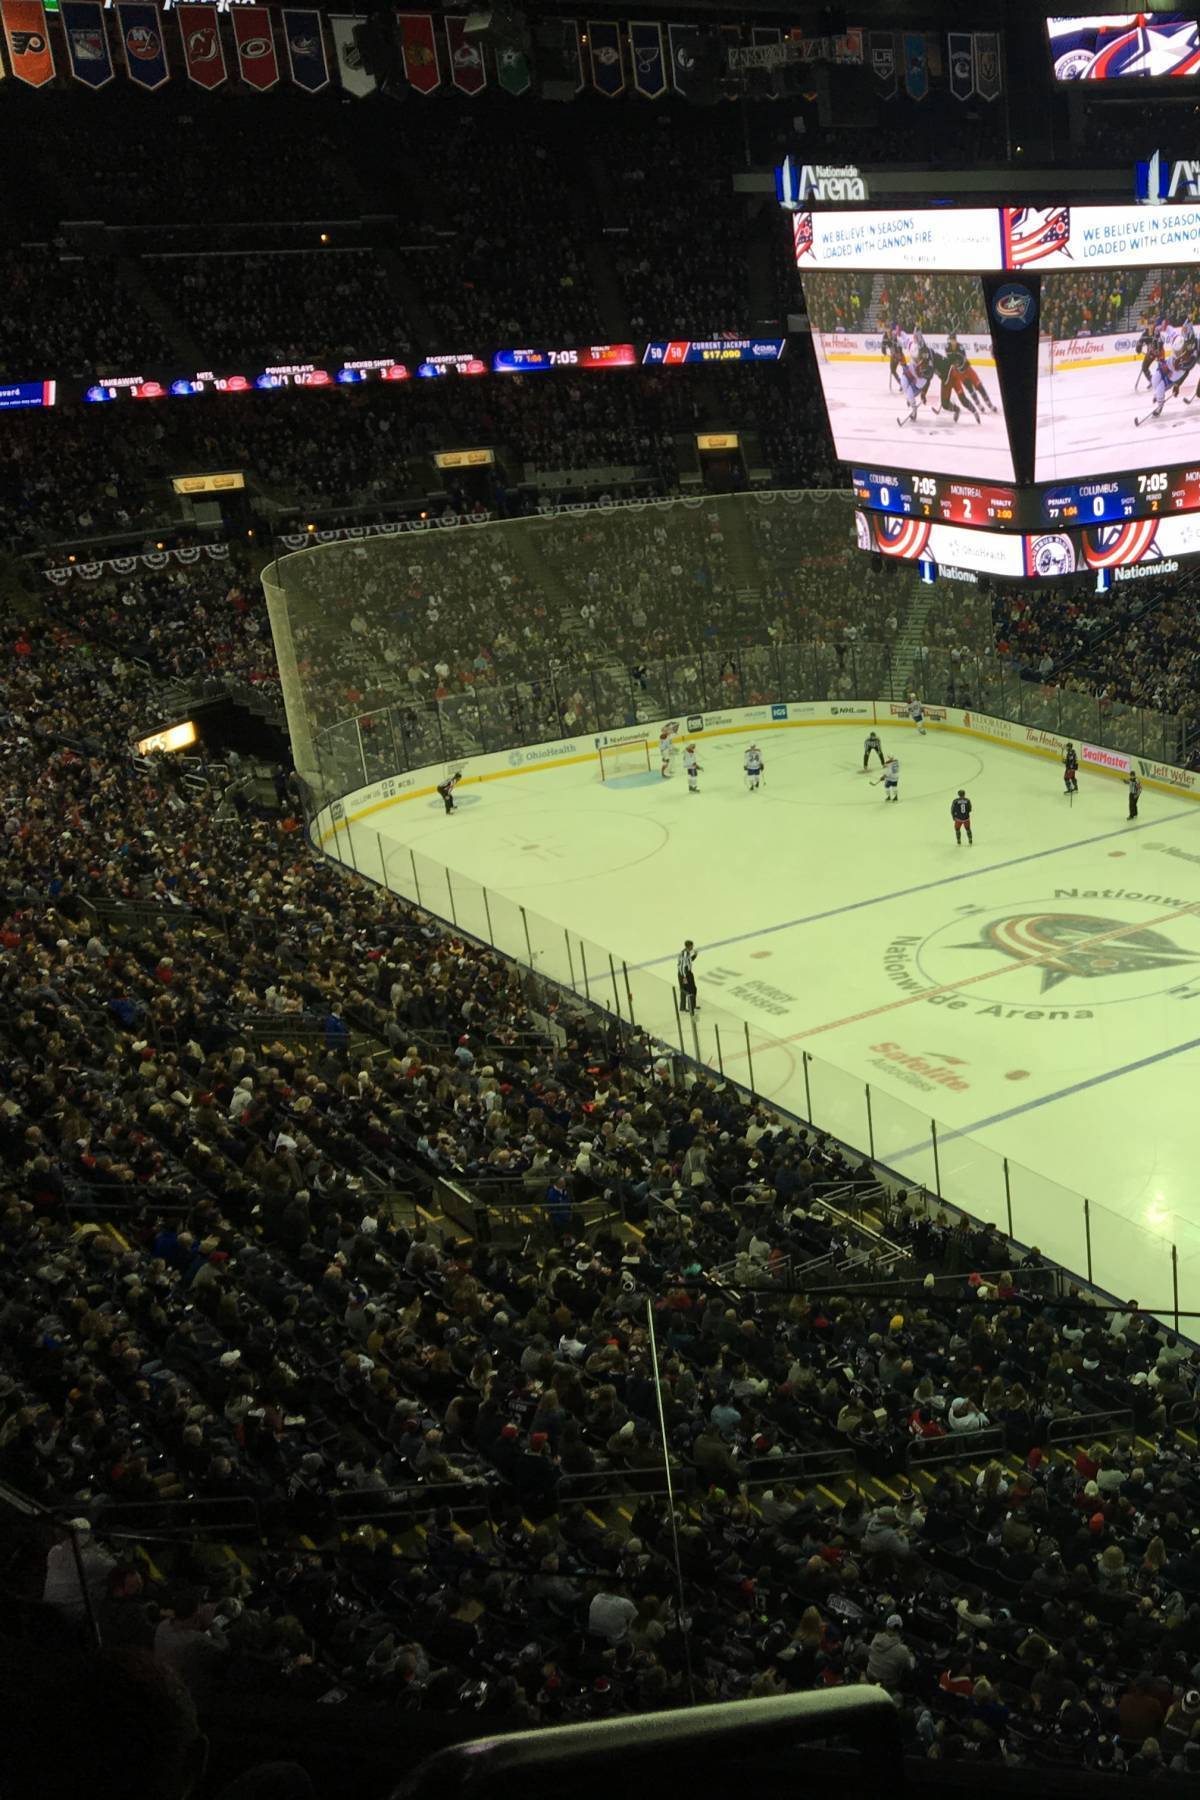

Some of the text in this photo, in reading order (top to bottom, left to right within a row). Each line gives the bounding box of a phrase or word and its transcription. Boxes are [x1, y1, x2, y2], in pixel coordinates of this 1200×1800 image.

[816, 165, 858, 178] Nationwide
[799, 165, 865, 200] Arena
[836, 226, 865, 242] BELIEVE
[877, 218, 914, 235] SEASONS
[1083, 228, 1100, 241] WE
[1104, 221, 1145, 238] BELIEVE
[1149, 219, 1159, 231] IN
[823, 245, 852, 260] LOADED
[877, 234, 913, 251] CANNON
[1083, 240, 1126, 258] LOADED
[1130, 234, 1157, 249] WITH
[692, 340, 750, 351] CURRENT JACKPOT
[1067, 339, 1105, 355] Hortons
[426, 353, 474, 364] FACEOFFS WON
[548, 350, 578, 364] 7:05
[651, 347, 662, 359] 50
[265, 364, 314, 375] POWER PLAYS
[344, 359, 394, 370] BLOCKED SHOTS
[436, 364, 447, 374] 14
[99, 376, 143, 388] TAKEAWAYS
[214, 379, 227, 390] 10
[271, 375, 288, 386] 0/1
[294, 373, 312, 385] 0/2
[191, 381, 204, 391] 10
[870, 473, 899, 487] COLUMBUS
[912, 476, 937, 496] 7:05
[1138, 473, 1168, 494] 7:05
[880, 488, 889, 506] 0
[951, 485, 982, 499] MONTREAL
[1079, 483, 1119, 498] COLUMBUS
[1146, 493, 1162, 501] PERIOD
[1172, 489, 1186, 498] SHOTS
[991, 499, 1012, 508] PENALTY
[1048, 497, 1071, 506] PENALTY
[1093, 497, 1104, 517] 0
[1121, 497, 1135, 506] SHOTS
[1152, 502, 1158, 512] 2
[1176, 499, 1184, 508] 12
[924, 505, 930, 515] 2
[963, 499, 972, 519] 2
[997, 508, 1013, 519] 2:00
[1050, 506, 1078, 518] 77 1:04
[1124, 506, 1133, 516] 21
[963, 545, 1007, 561] OhioHealth
[1114, 559, 1179, 581] Nationwide
[774, 708, 786, 717] IGS
[610, 732, 650, 744] Nationwide
[1026, 728, 1039, 742] Tim
[526, 742, 577, 762] OhioHealth
[1082, 747, 1128, 769] SealMaster
[1152, 763, 1169, 777] Jeff
[1170, 769, 1196, 785] Wyler
[960, 803, 966, 814] 8
[883, 935, 1094, 1020] Nationwide Arena
[744, 979, 799, 1003] ENERGY
[726, 985, 790, 1016] TRANSFER
[868, 1042, 970, 1092] Safelite
